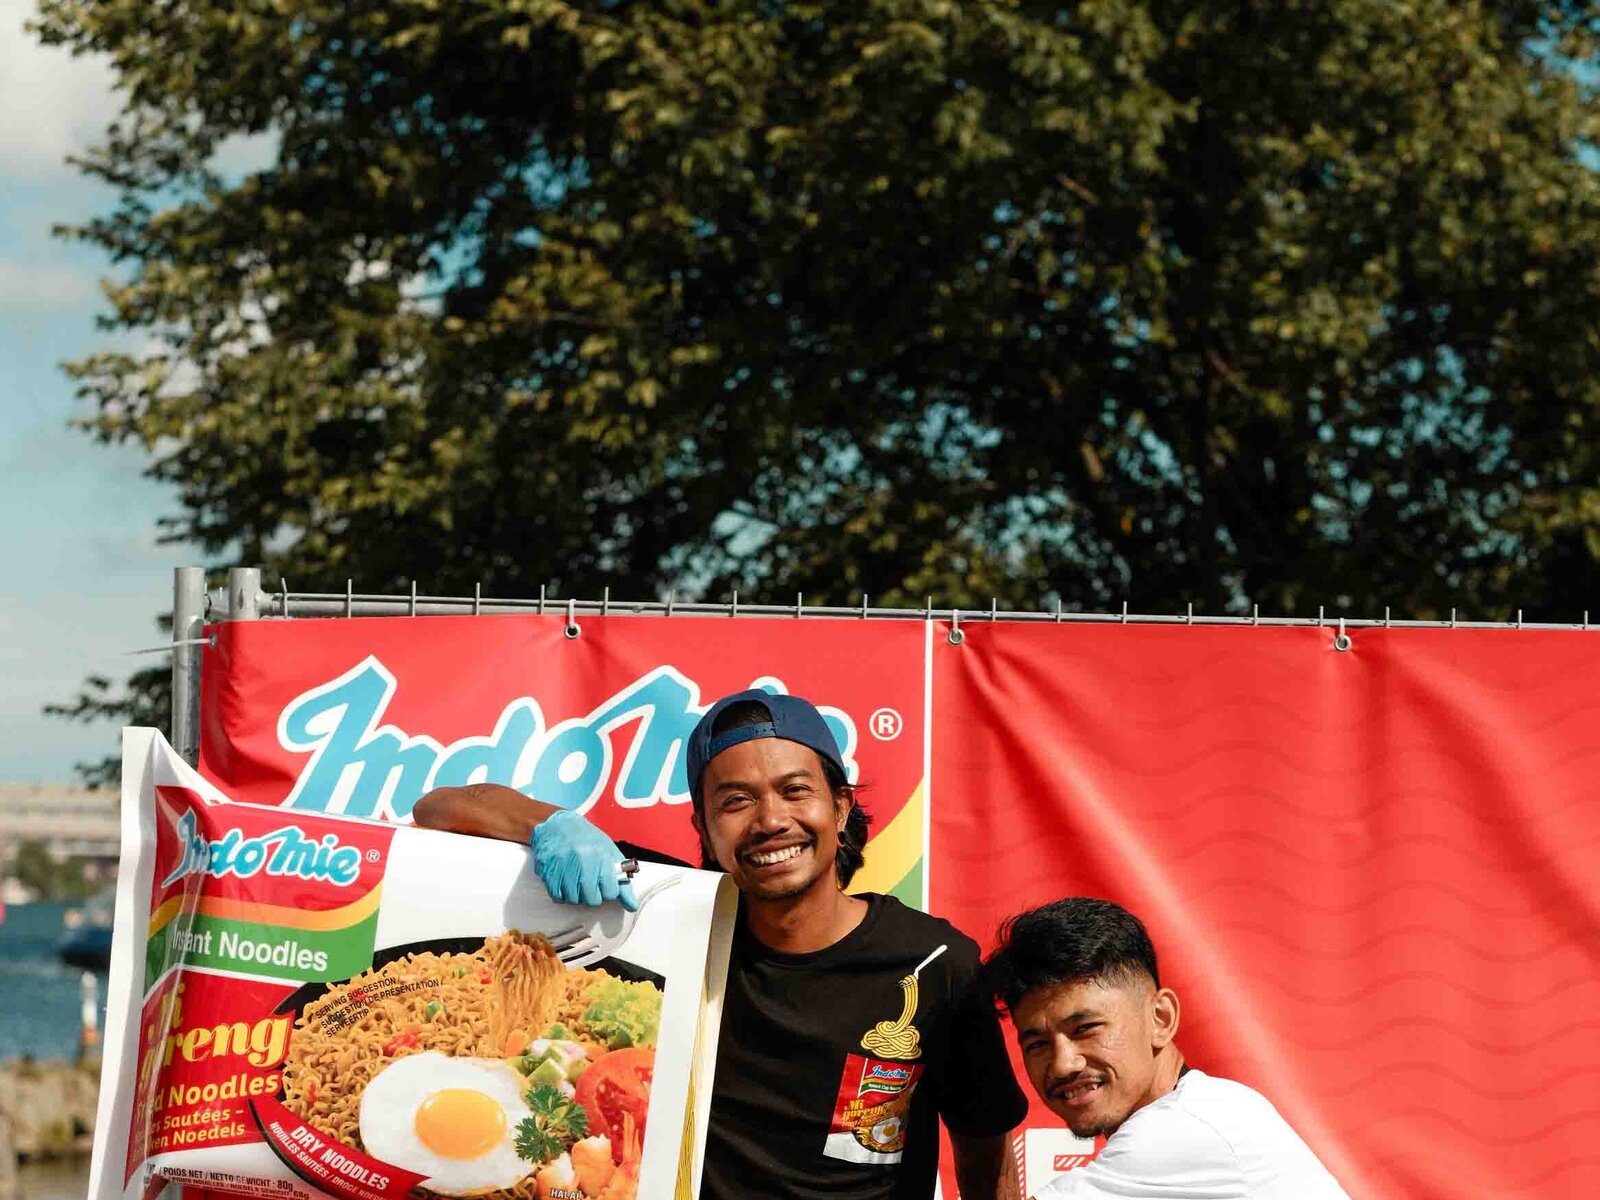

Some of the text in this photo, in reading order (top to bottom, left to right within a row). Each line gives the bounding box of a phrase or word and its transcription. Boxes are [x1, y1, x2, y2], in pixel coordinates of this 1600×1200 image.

[218, 931, 329, 973] Noodles
[315, 995, 350, 1020] SERVING
[346, 977, 397, 1001] SUGGESTION
[320, 1000, 368, 1029] SUGGESTION
[368, 993, 381, 1005] DE
[325, 1007, 370, 1038] SERVEERTIP
[146, 1015, 291, 1075] reng
[170, 1073, 280, 1107] Noodles
[163, 1107, 231, 1129] Sautées
[172, 1122, 246, 1146] Noedels
[269, 1120, 300, 1155] NOUILLES
[296, 1150, 330, 1179] SAUTÉES
[331, 1175, 359, 1194] DROGE
[290, 1126, 390, 1191] DRY NOODLES
[163, 1166, 187, 1178] POIDS
[188, 1170, 204, 1180] NET
[210, 1172, 235, 1183] NETTO
[235, 1175, 271, 1188] GEWICHT
[277, 1179, 294, 1193] 80g
